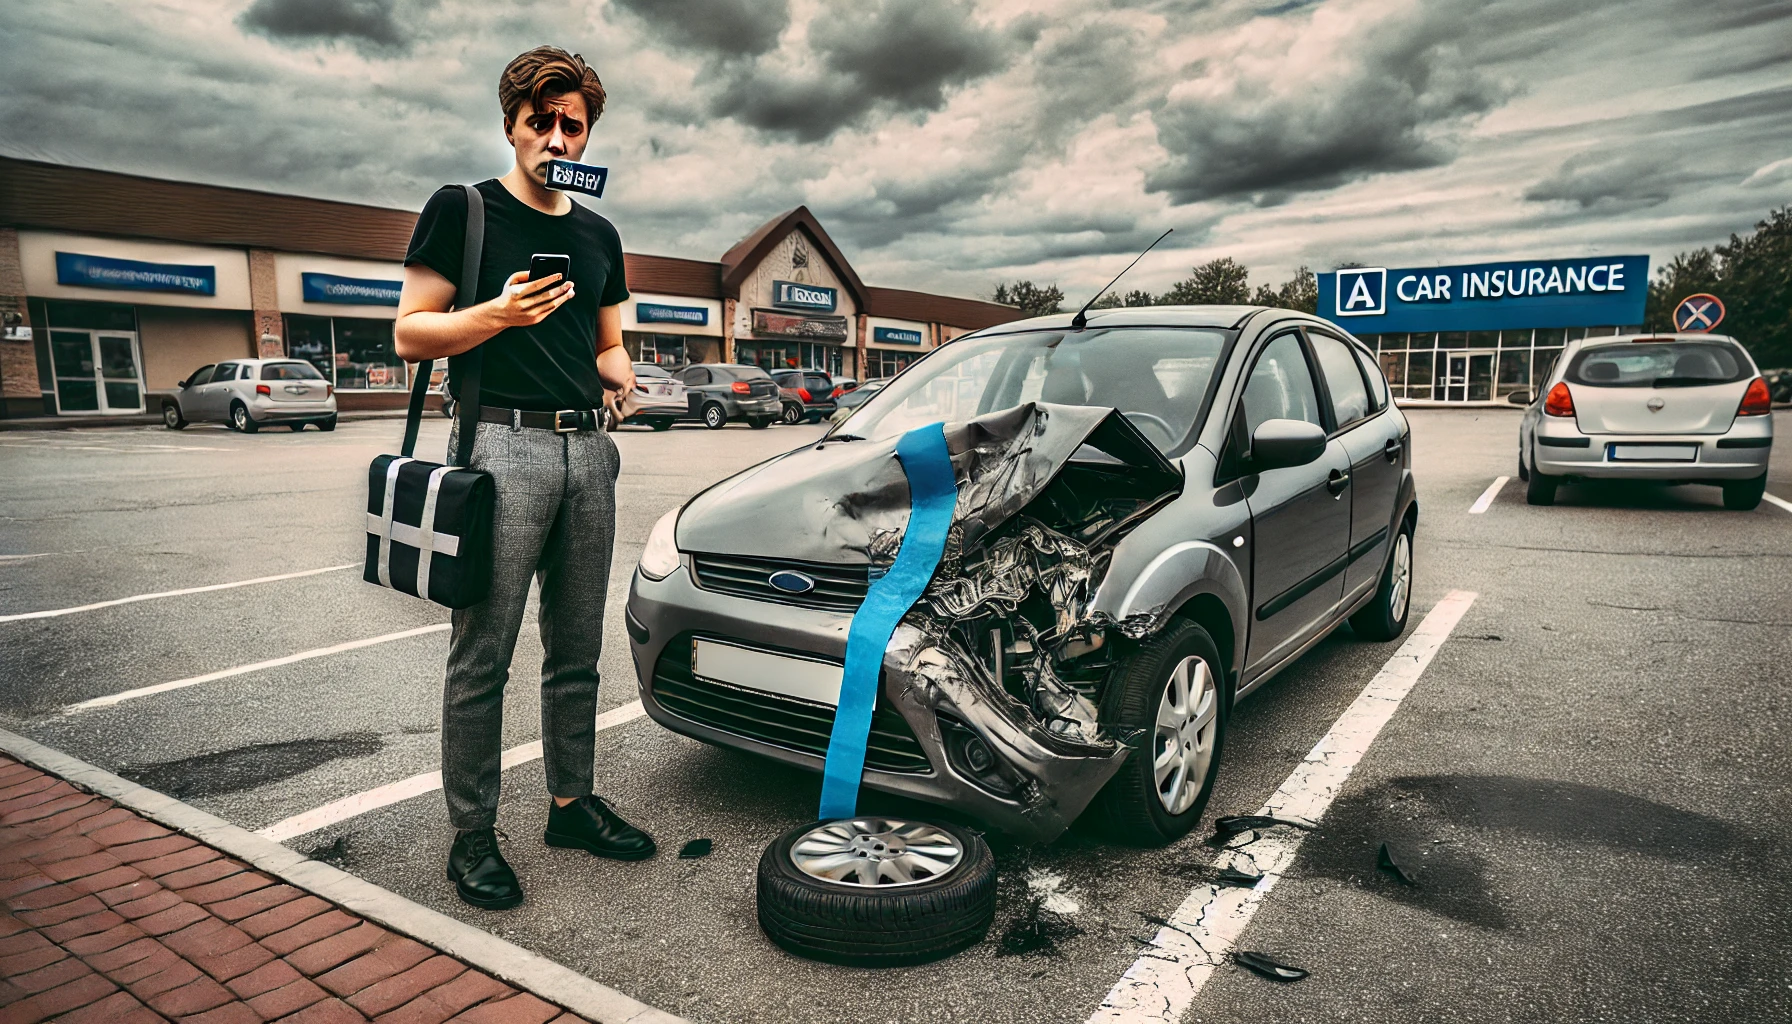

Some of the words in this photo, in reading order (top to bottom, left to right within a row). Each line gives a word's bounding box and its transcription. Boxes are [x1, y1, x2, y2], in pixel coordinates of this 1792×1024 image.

[1345, 274, 1376, 310] A
[1396, 274, 1452, 302] CAR
[1461, 263, 1626, 298] INSURANCE
